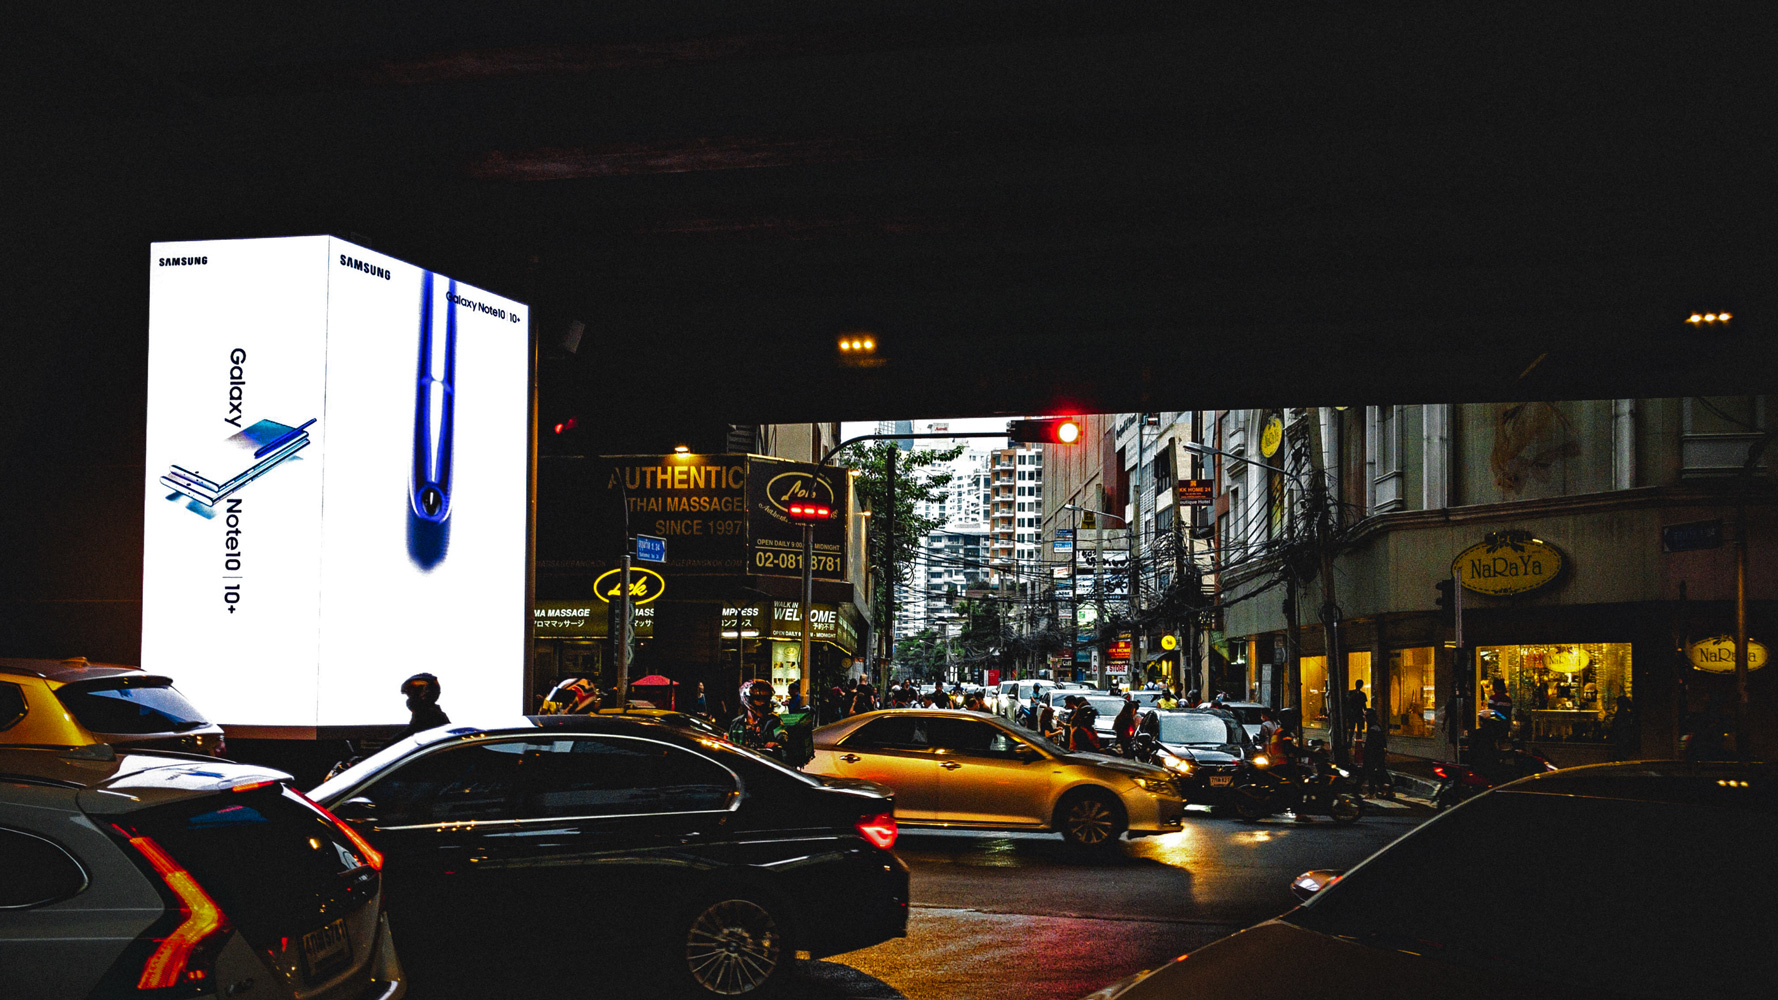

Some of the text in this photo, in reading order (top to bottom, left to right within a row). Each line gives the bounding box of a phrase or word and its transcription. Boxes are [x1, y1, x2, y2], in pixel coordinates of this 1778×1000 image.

[158, 255, 208, 267] SAMSUNG
[340, 254, 391, 281] SAMSUNG
[446, 291, 478, 312] Galaxy
[478, 302, 506, 320] Note10
[224, 347, 247, 428] Galaxy
[607, 465, 745, 490] AUTHENTIC
[628, 496, 744, 513] THAI MASSAGE
[224, 498, 243, 571] Note10
[655, 519, 743, 536] SINCE 1997
[756, 538, 774, 546] OPEN
[1470, 555, 1543, 580] NaRaYa
[547, 608, 591, 617] MASSAGE
[773, 600, 791, 608] WALK
[774, 607, 837, 624] WELOME
[1699, 648, 1757, 663] NaRaa
